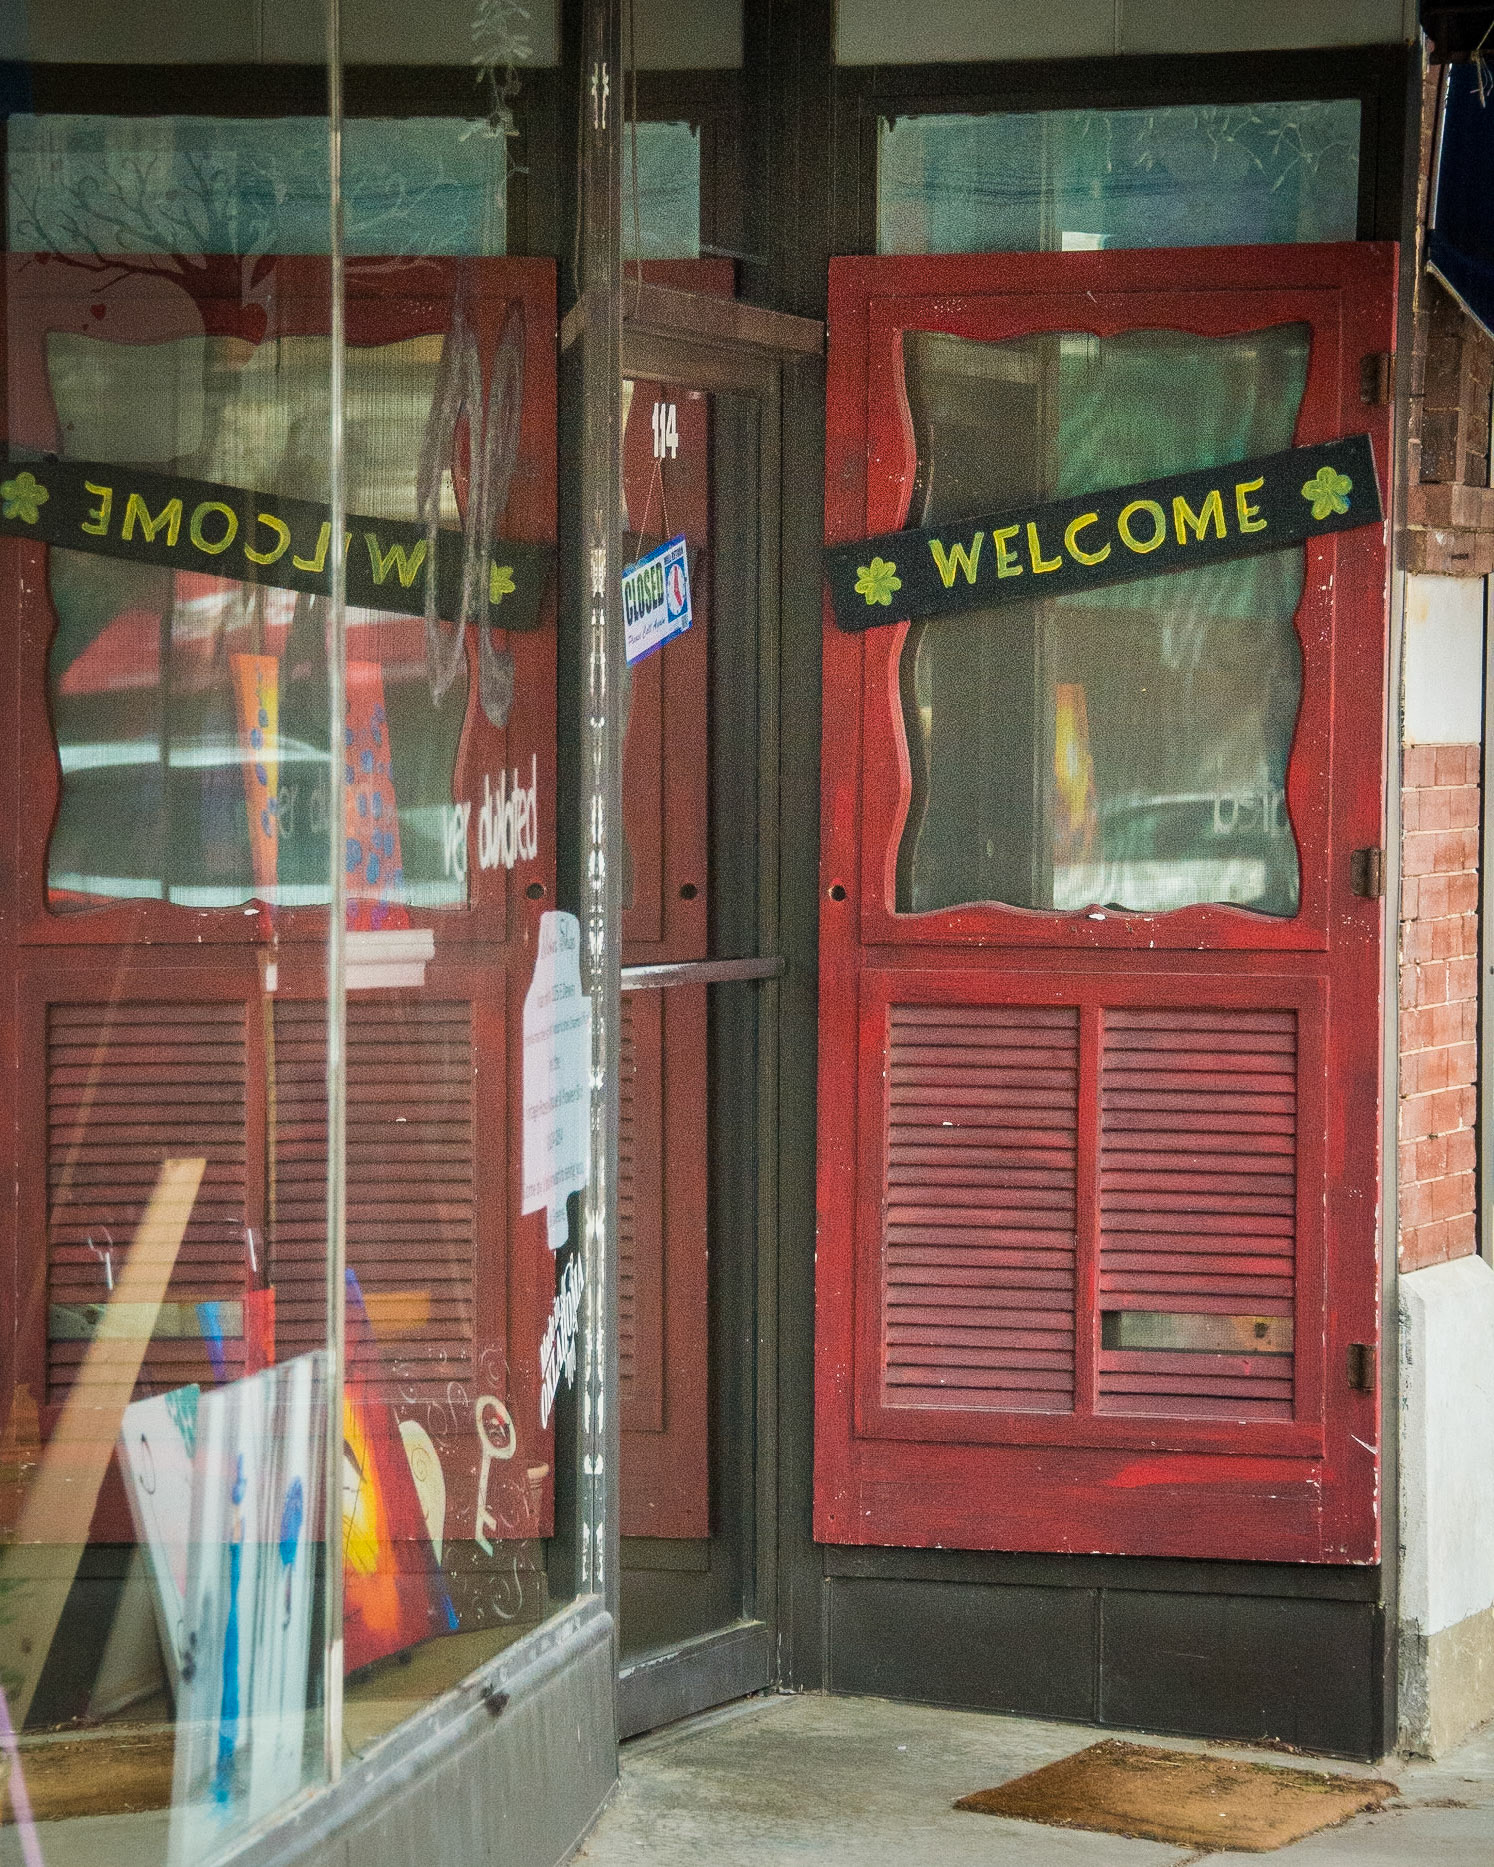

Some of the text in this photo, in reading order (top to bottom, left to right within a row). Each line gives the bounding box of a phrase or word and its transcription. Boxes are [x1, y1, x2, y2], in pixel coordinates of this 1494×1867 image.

[652, 402, 678, 459] 114
[930, 476, 1268, 588] WELCOME
[624, 562, 664, 627] CLOSED
